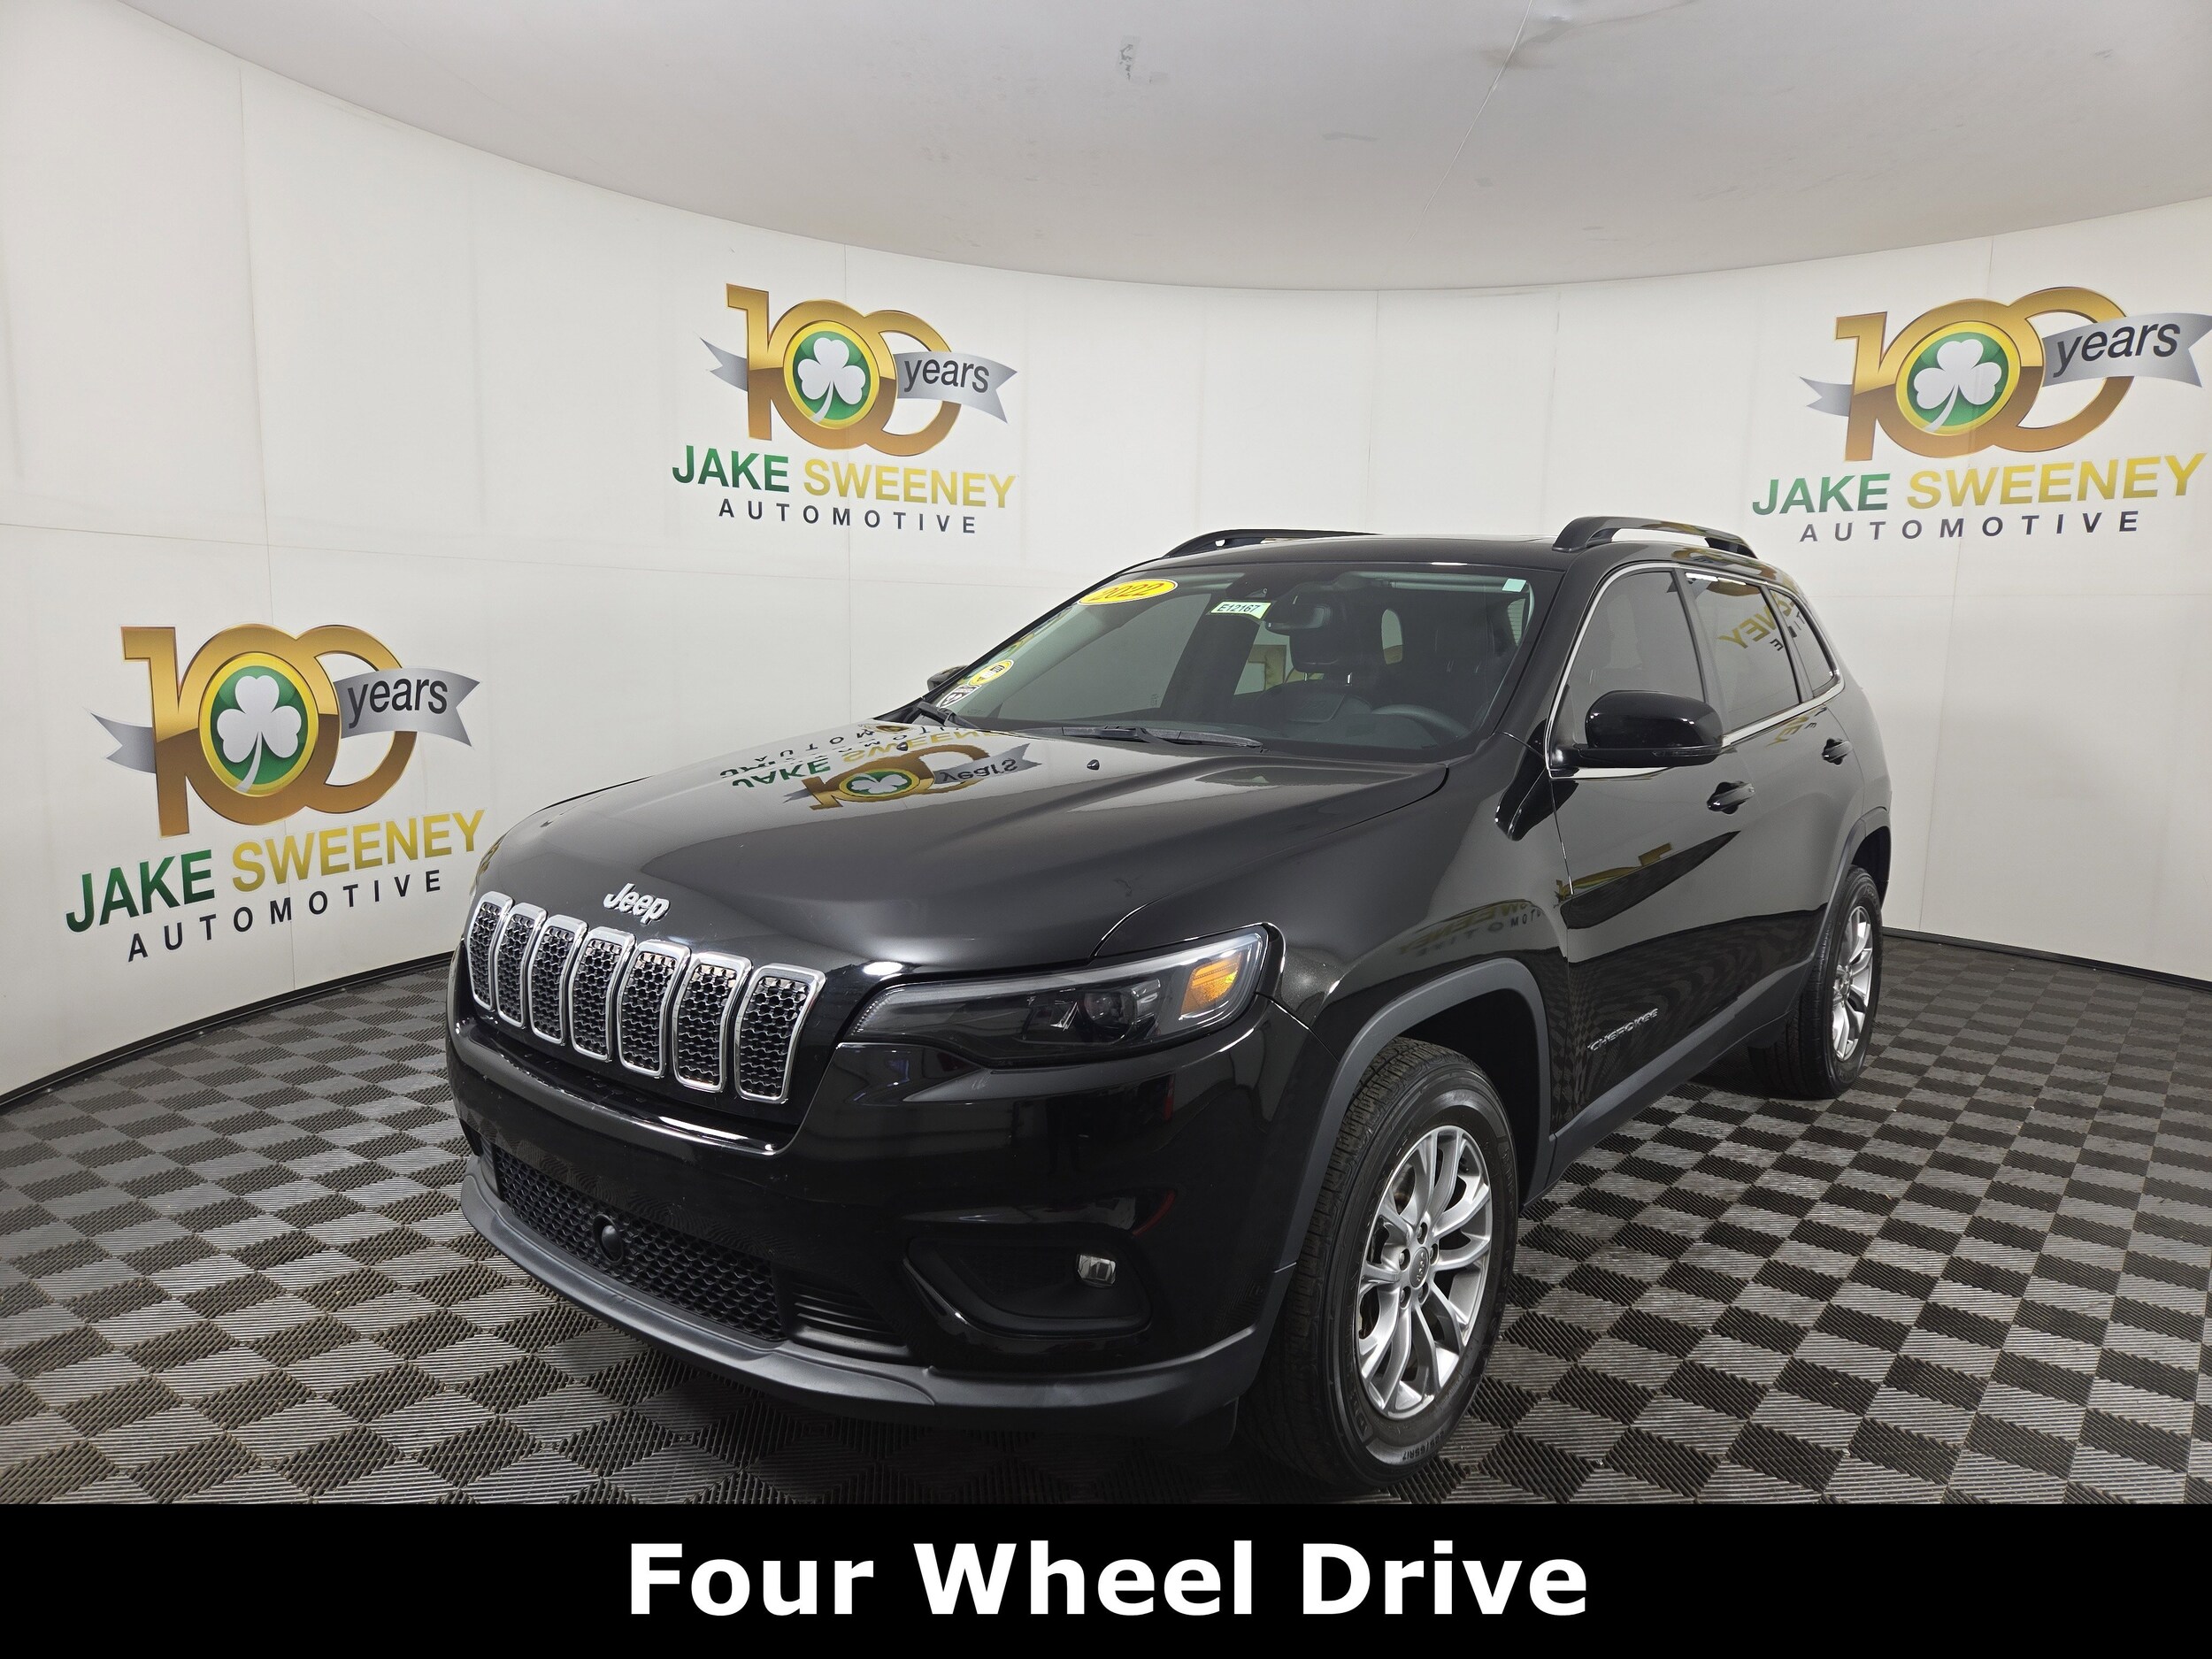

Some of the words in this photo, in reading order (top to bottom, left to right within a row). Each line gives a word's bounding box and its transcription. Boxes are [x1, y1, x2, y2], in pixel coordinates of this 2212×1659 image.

[726, 283, 961, 457] 100
[903, 357, 990, 393] years
[1835, 286, 2134, 462] 100
[2053, 322, 2181, 378] years
[672, 445, 790, 493] JAKE
[803, 459, 1017, 509] SWEENEY
[1752, 473, 1891, 516] JAKE
[1906, 452, 2208, 510] SWEENEY
[718, 498, 975, 534] AUTOMOTIVE
[1800, 510, 2139, 543] AUTOMOTIVE
[1087, 582, 1164, 602] 2022
[1217, 603, 1261, 613] E12167
[121, 623, 417, 838] 100
[348, 678, 449, 729] years
[65, 849, 215, 933] JAKE
[232, 809, 485, 892] SWEENEY
[127, 869, 442, 962] AUTOMOTIVE
[603, 882, 671, 926] Jeep
